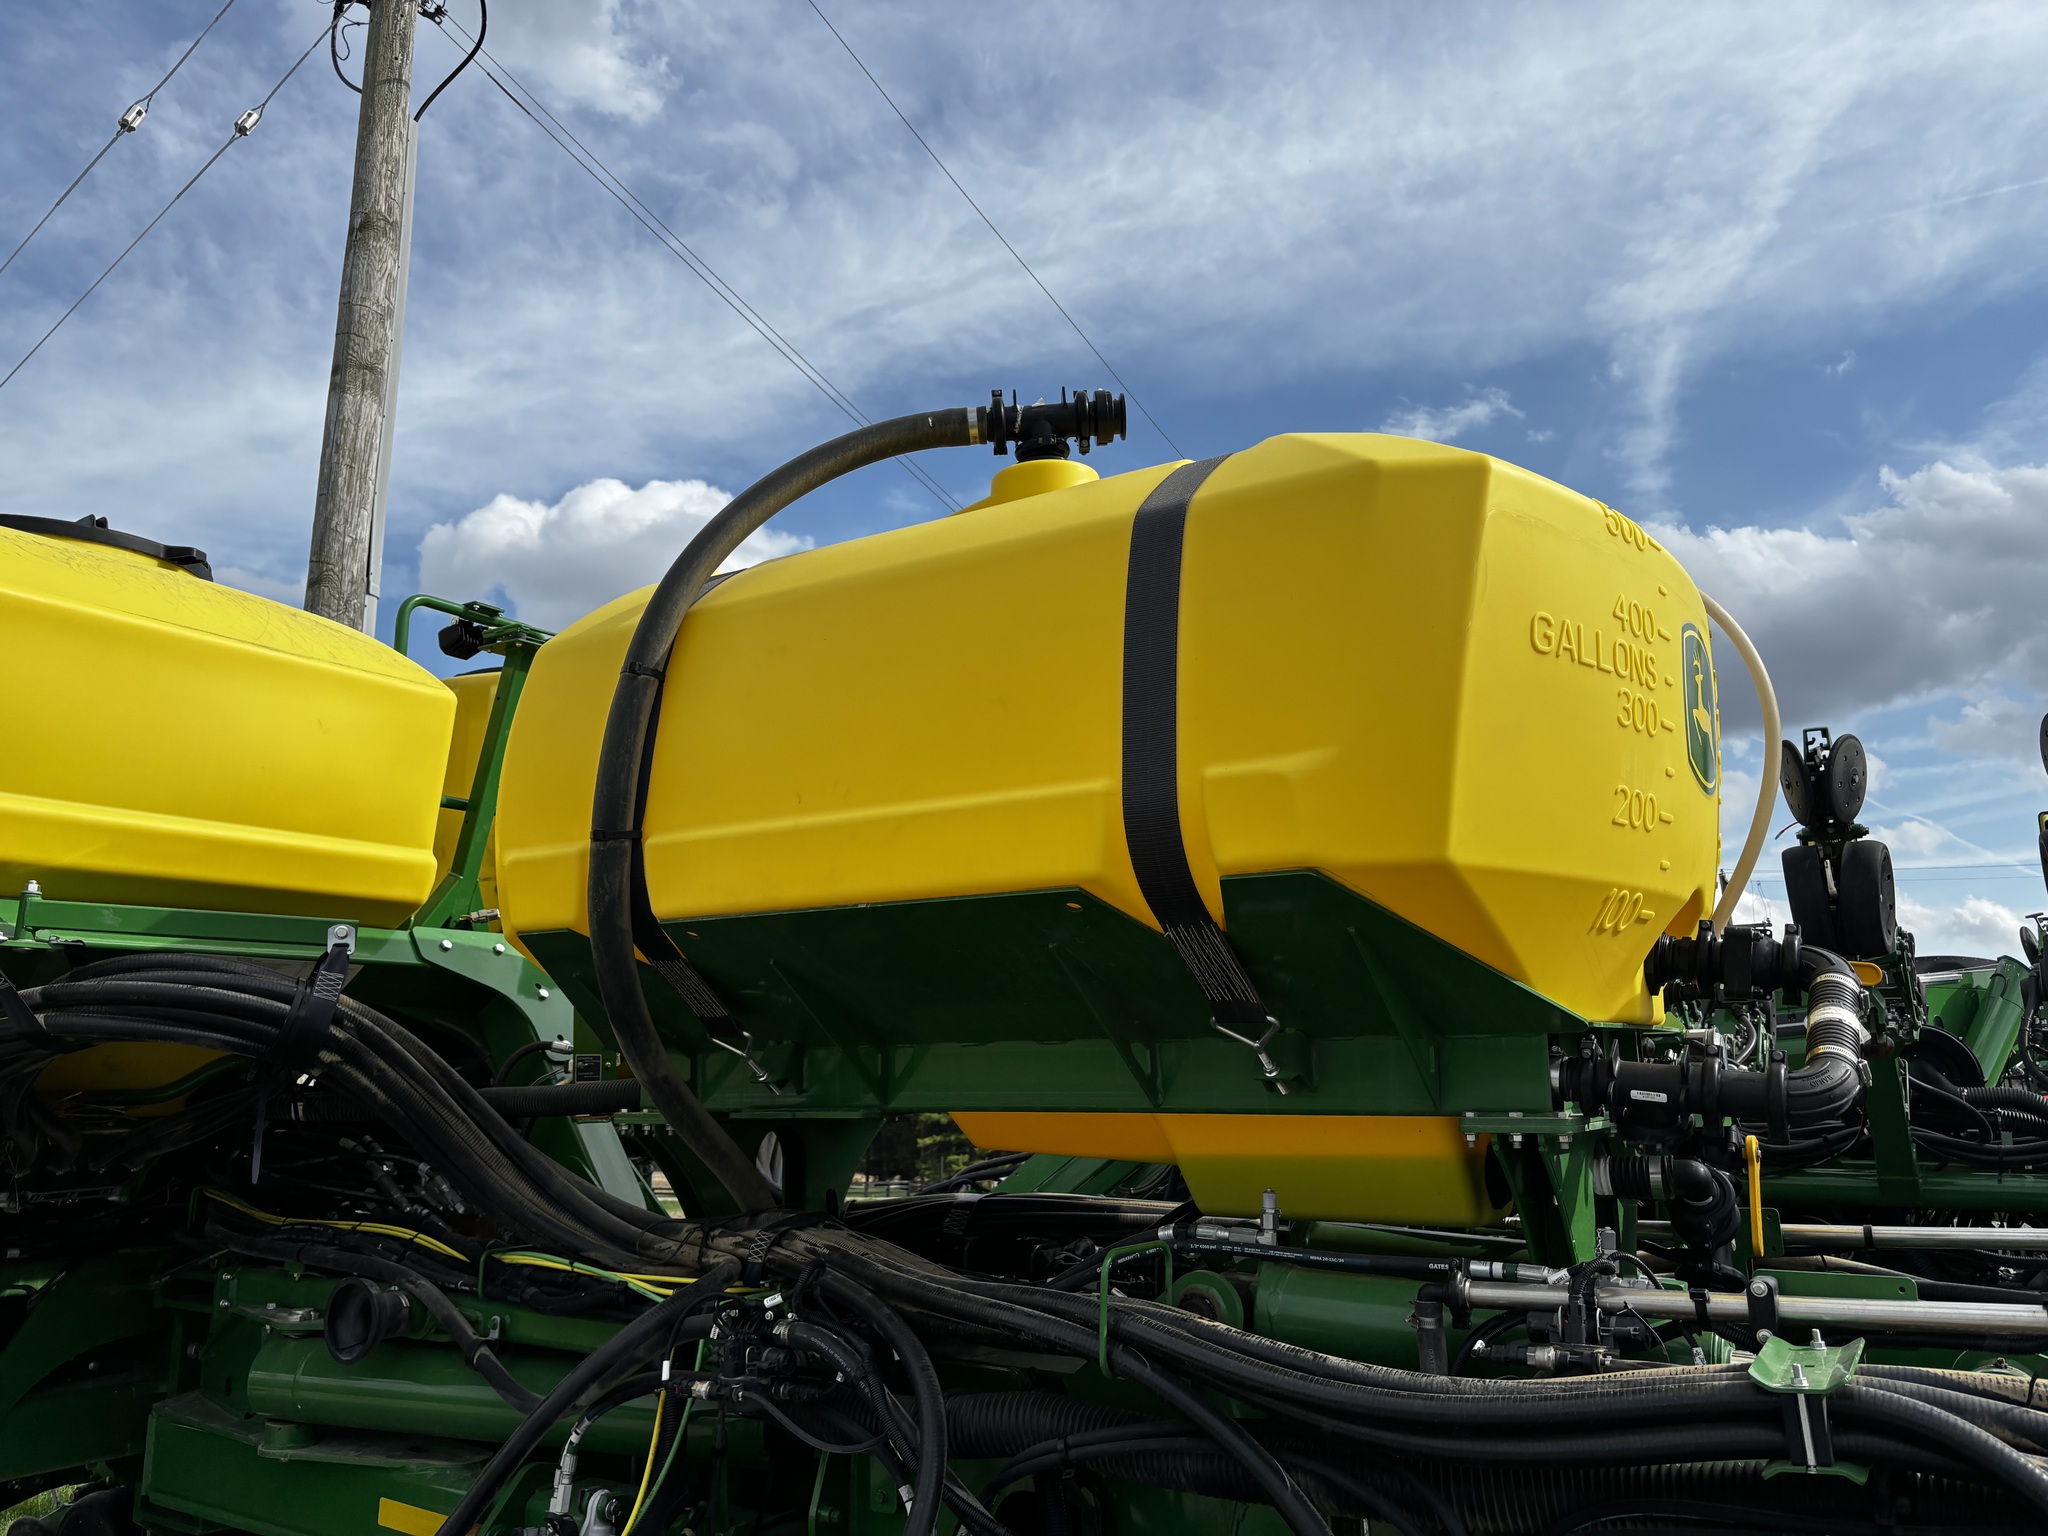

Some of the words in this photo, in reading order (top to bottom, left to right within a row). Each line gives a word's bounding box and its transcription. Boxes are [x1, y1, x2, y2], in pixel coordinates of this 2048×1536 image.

[1593, 498, 1646, 552] 500
[1612, 593, 1655, 644] 400
[1530, 611, 1657, 691] GALLONS
[1617, 687, 1658, 737] 300
[1612, 784, 1657, 832] 200
[1592, 887, 1644, 934] 100
